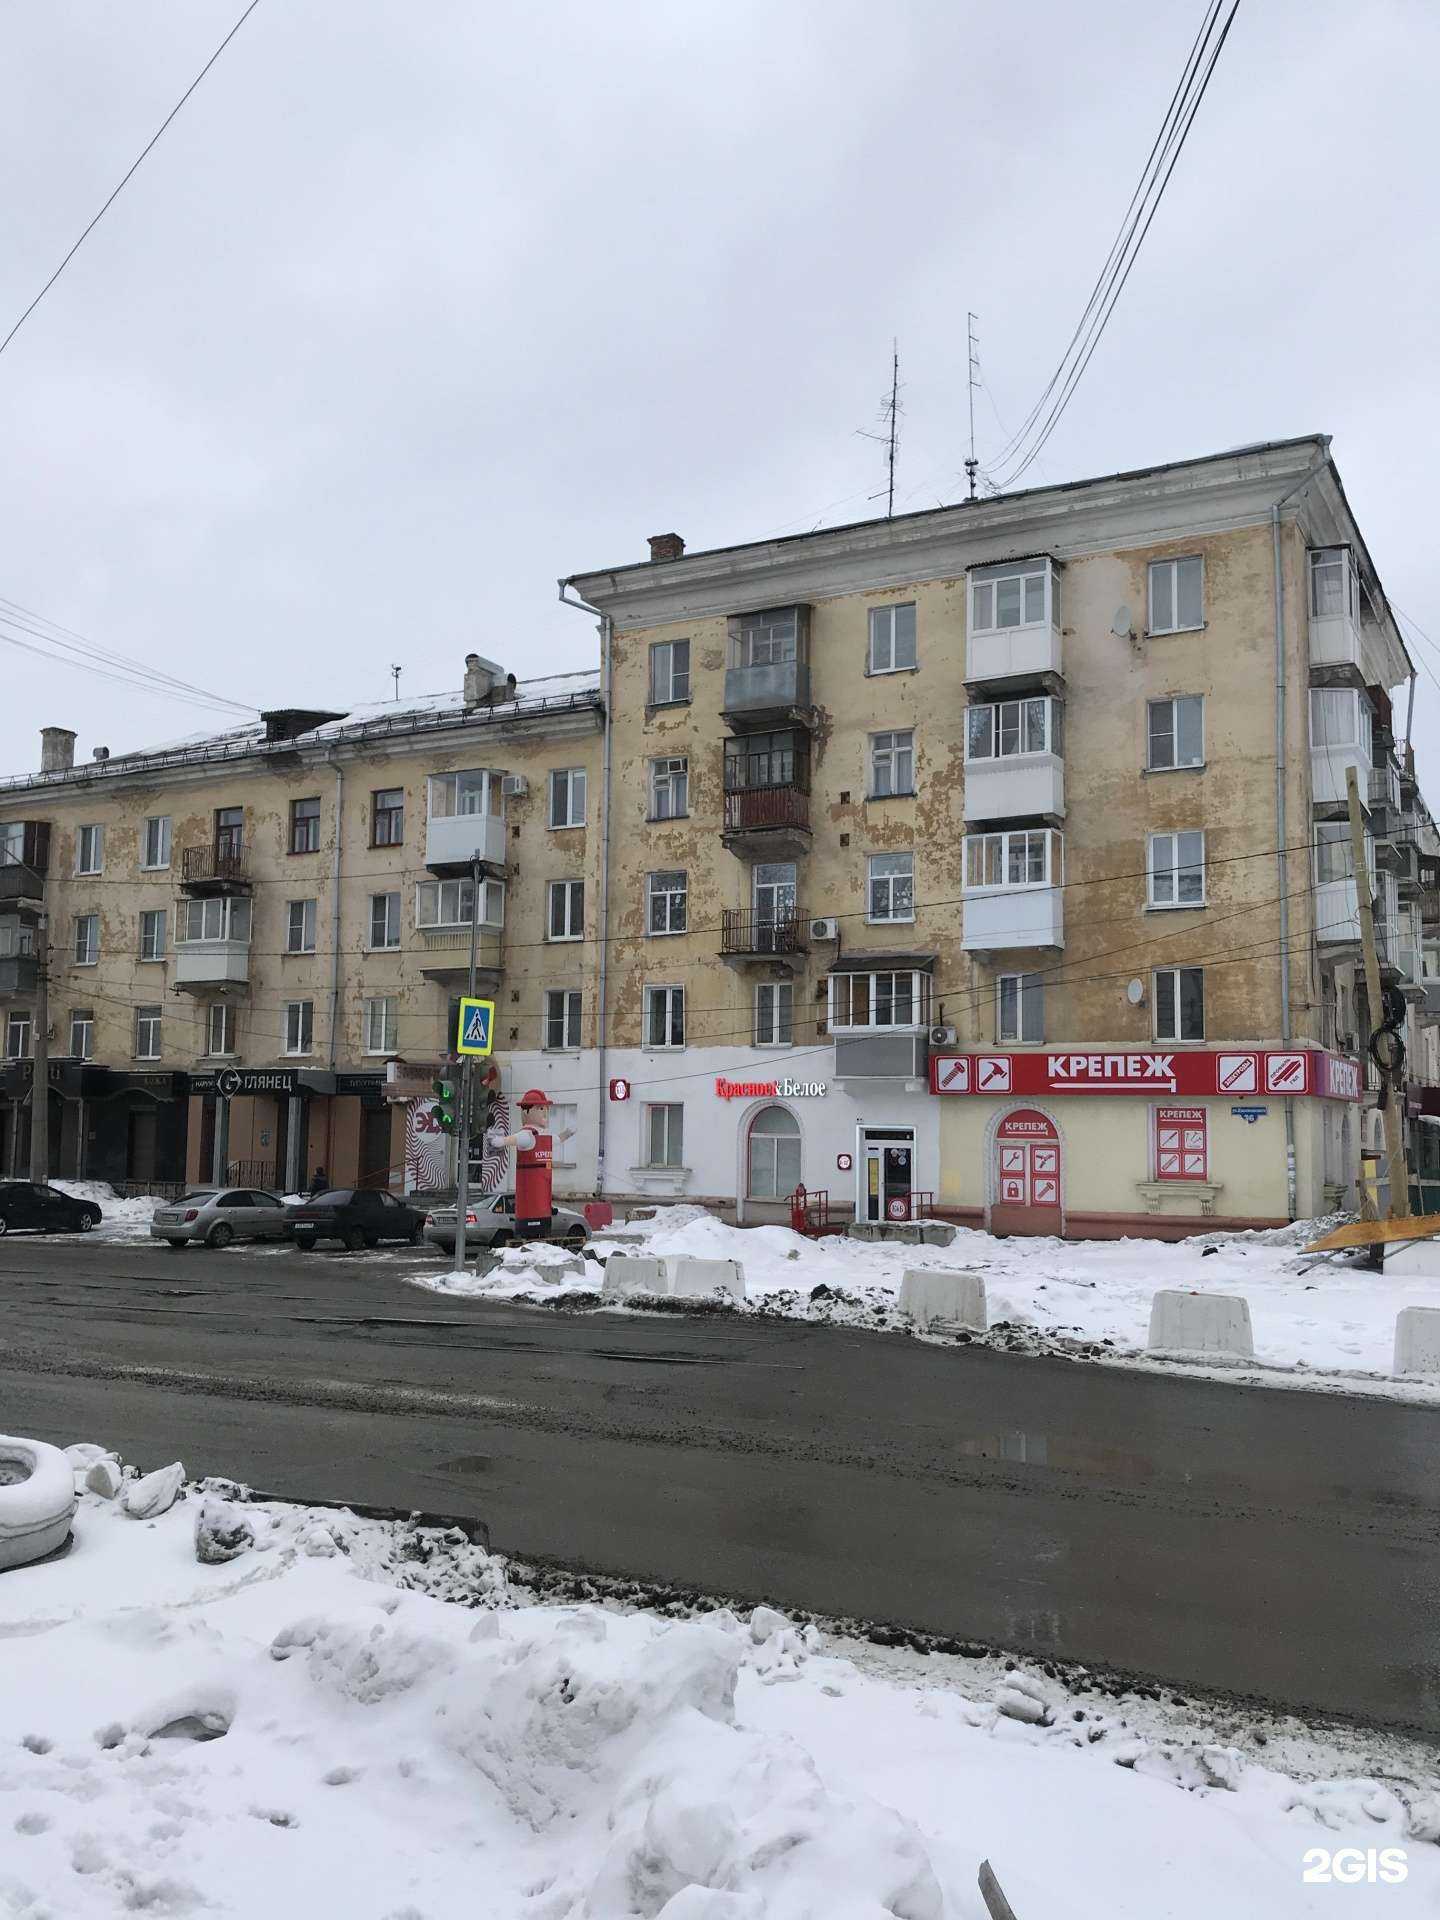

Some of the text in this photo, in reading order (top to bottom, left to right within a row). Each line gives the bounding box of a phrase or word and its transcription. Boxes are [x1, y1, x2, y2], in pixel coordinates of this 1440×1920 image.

[1048, 1055, 1176, 1077] КРЕПЕЖ
[244, 1075, 292, 1092] ГЛЯНЕЦ
[1329, 1058, 1359, 1098] КРЕПЕЖ
[1160, 1110, 1202, 1119] КРЕПЕЖ
[1005, 1122, 1048, 1131] КРЕПЕЖ
